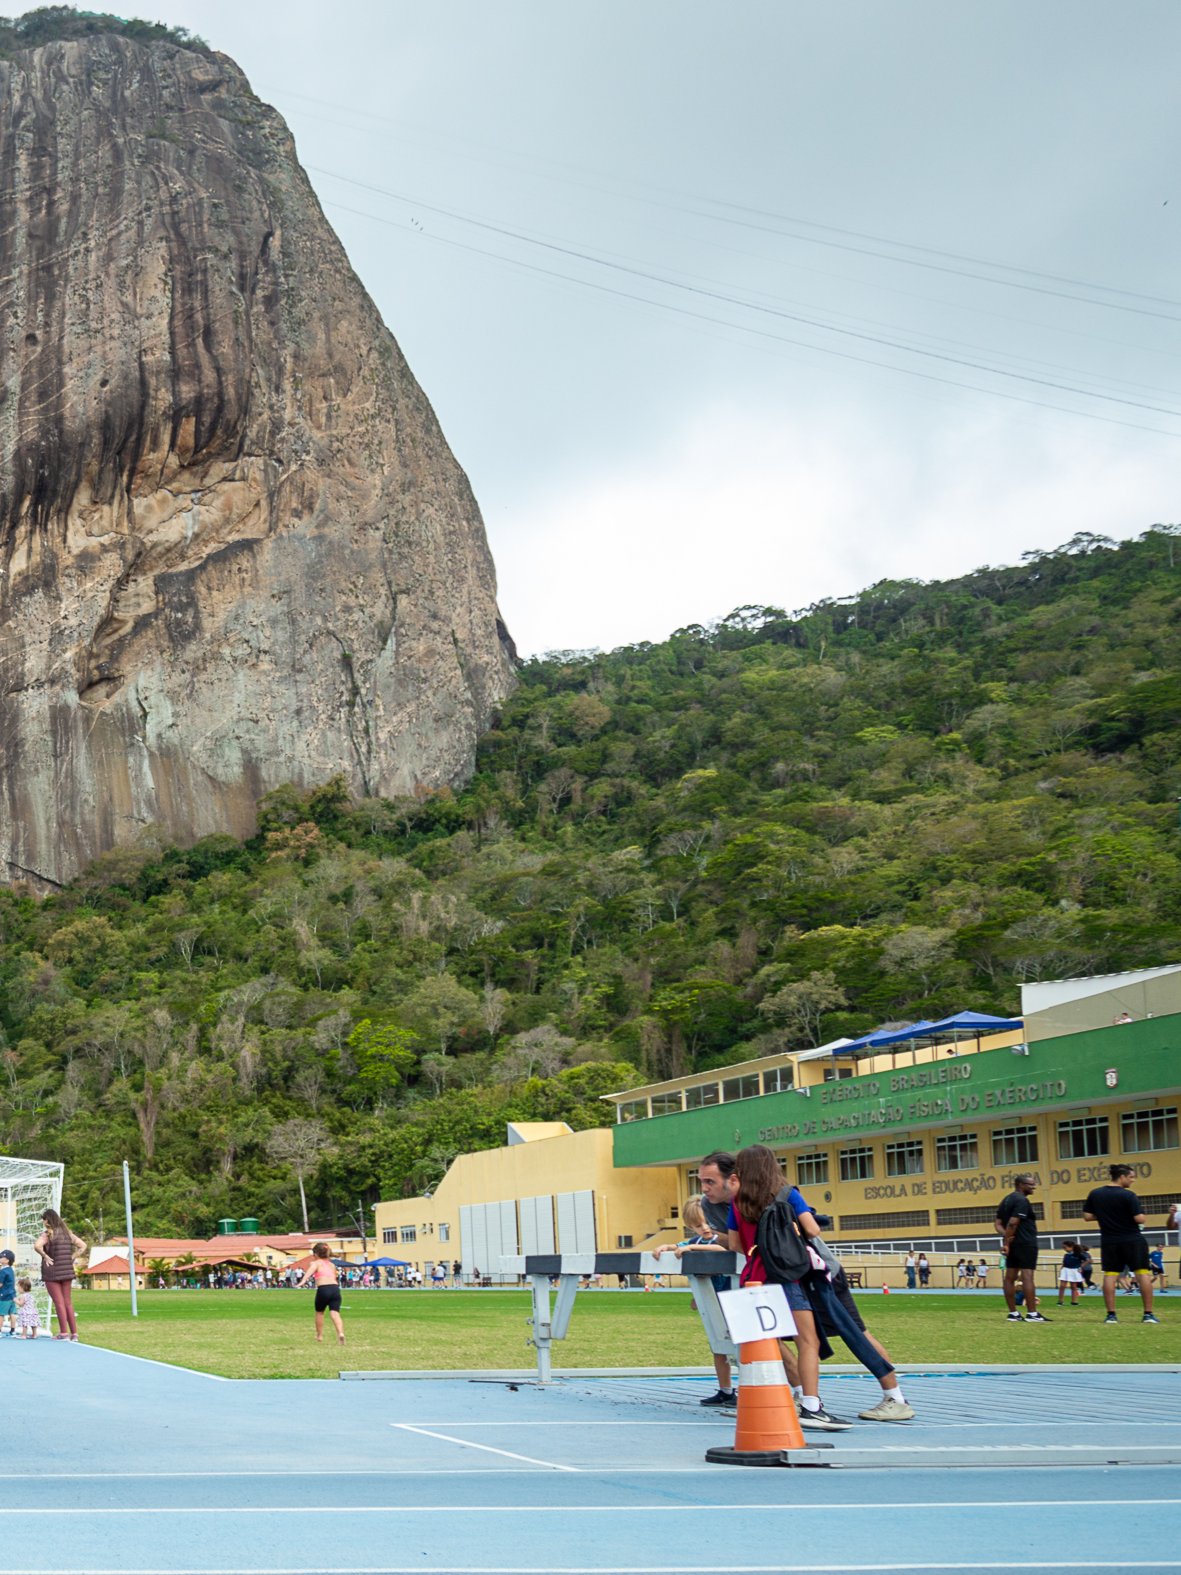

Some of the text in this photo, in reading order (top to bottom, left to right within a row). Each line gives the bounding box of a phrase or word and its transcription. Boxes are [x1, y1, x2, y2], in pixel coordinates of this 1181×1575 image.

[821, 1063, 971, 1104] EXÉRCITO BRASILEIRO
[758, 1081, 1068, 1141] CENTRO DE CAPACITAÇÃO FÍSICA DO EXÉRCITO
[864, 1183, 908, 1200] ESCOLA
[911, 1181, 928, 1197] DE
[932, 1173, 997, 1195] EDUCAÇÃO
[1050, 1169, 1071, 1186] DO
[1077, 1162, 1152, 1183] EXÉTO
[755, 1305, 778, 1332] D
